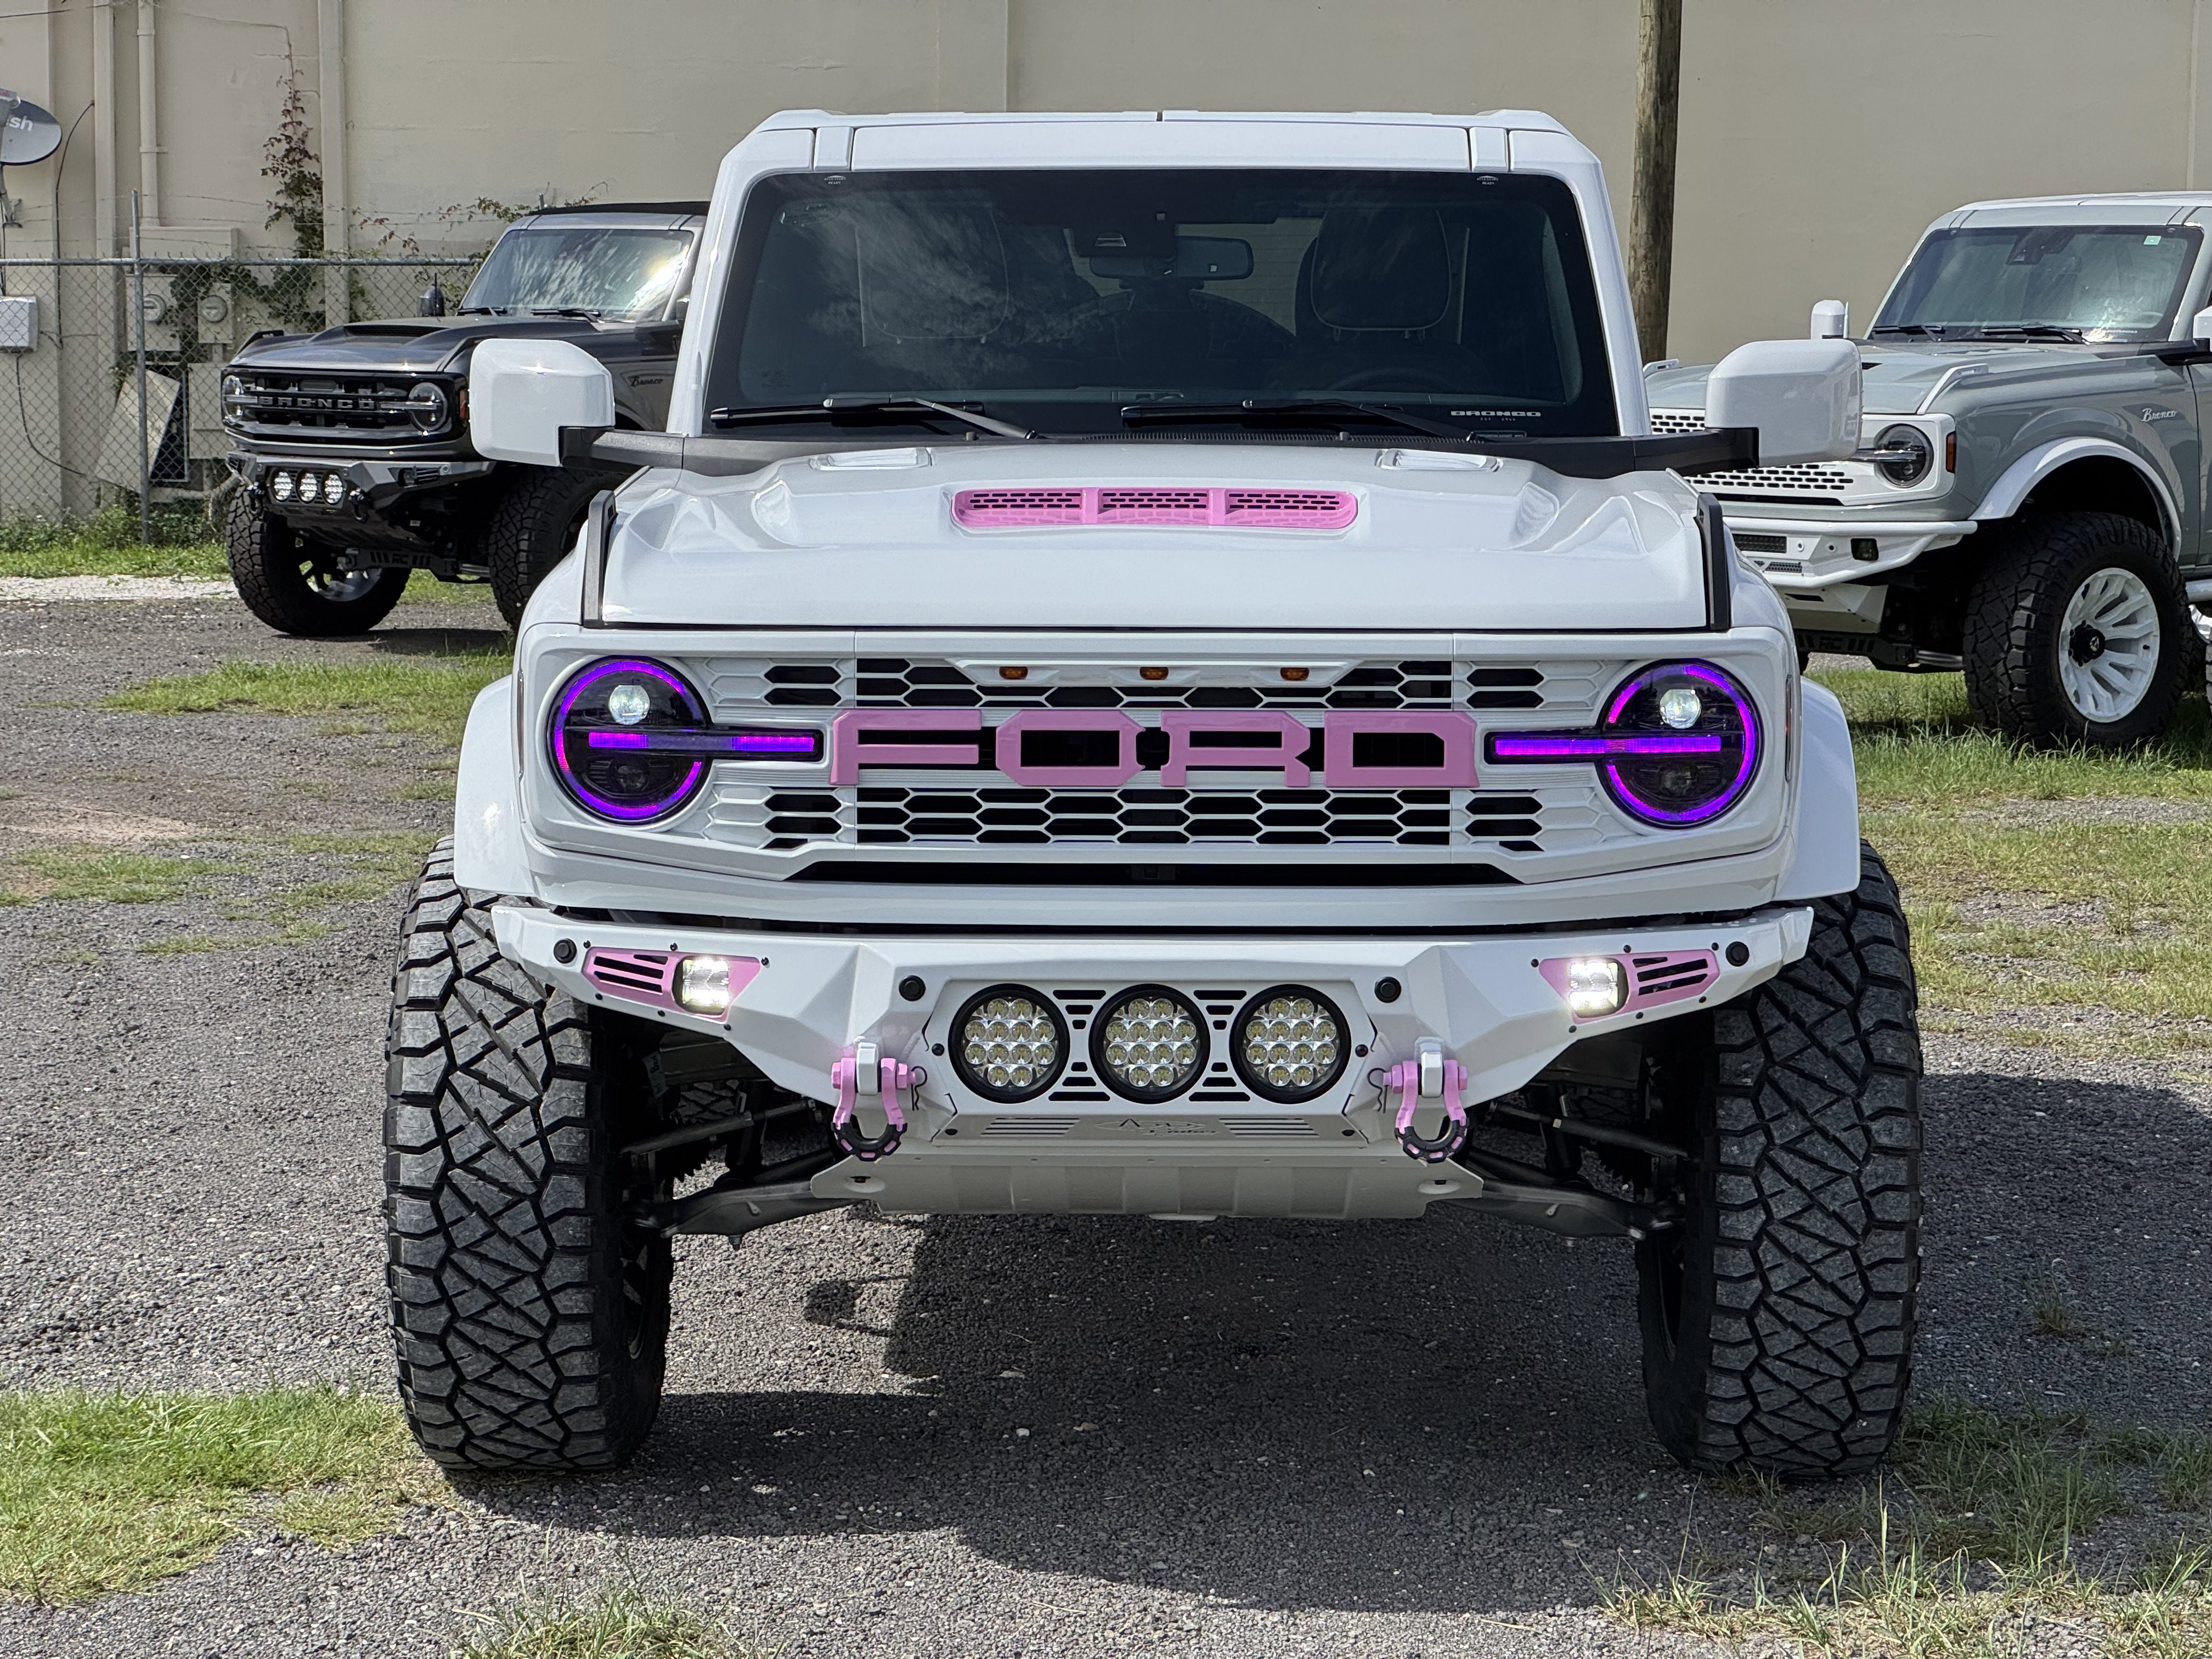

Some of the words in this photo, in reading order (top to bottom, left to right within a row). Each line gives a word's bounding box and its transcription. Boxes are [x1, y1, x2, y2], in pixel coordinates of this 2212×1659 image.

[628, 375, 663, 387] Bronco
[258, 396, 375, 410] BRONCO
[2141, 408, 2177, 422] Bronco
[828, 708, 1480, 789] FORD
